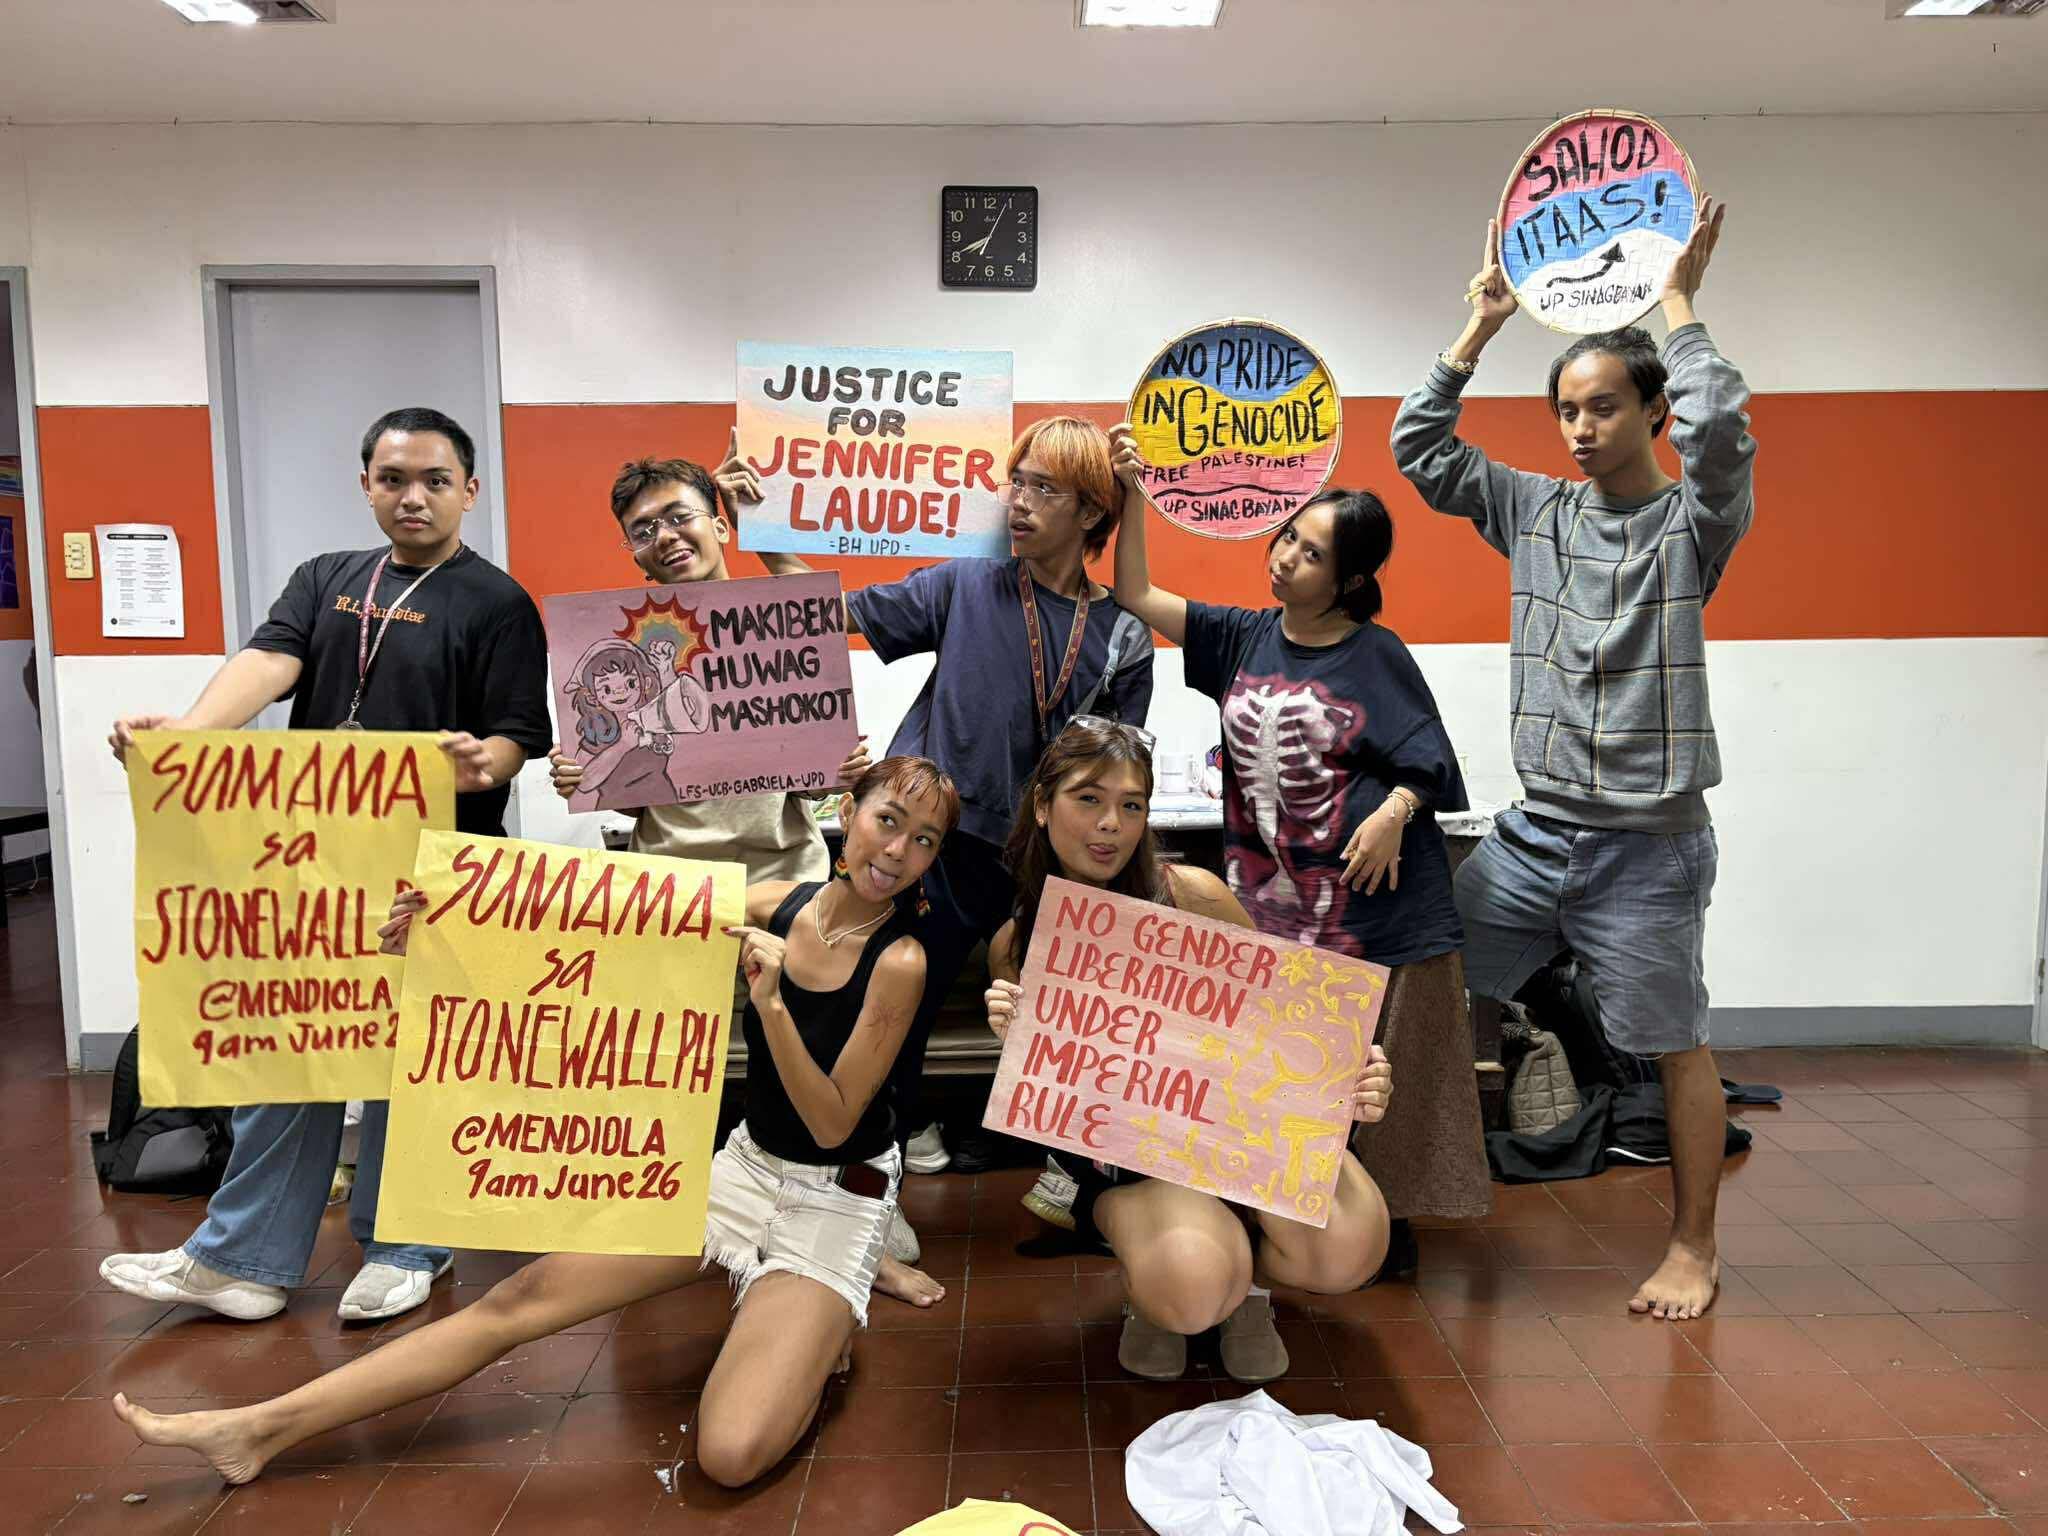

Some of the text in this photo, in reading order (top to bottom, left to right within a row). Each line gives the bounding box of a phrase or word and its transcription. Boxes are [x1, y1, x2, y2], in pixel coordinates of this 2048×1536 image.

[1523, 124, 1659, 202] SAHOD
[950, 210, 964, 222] 10
[965, 196, 976, 209] 11
[983, 196, 997, 209] 12
[1017, 211, 1027, 224] 2
[1516, 177, 1668, 266] ITAAS!
[951, 230, 961, 242] 9
[951, 251, 961, 263] 8
[1016, 252, 1027, 264] 4
[1017, 231, 1027, 243] 3
[966, 265, 976, 277] 7
[984, 265, 995, 277] 6
[1003, 265, 1014, 277] 5
[1540, 293, 1564, 311] UP
[763, 364, 962, 407] JUSTICE
[1161, 338, 1304, 391] NO PRIDE
[827, 406, 906, 437] FOR
[1177, 381, 1329, 457] GENOCIDE
[747, 435, 998, 492] JENNIFER
[1142, 452, 1305, 484] FREE PALESTINE!
[790, 482, 961, 538] LAUDE!
[1164, 499, 1188, 514] UP
[710, 597, 845, 648] MAKIBEKI
[702, 645, 821, 692] HUWAG
[711, 688, 852, 732] MASHOKOT
[152, 741, 428, 819] SUMAMA
[254, 831, 317, 871] sa
[426, 844, 713, 942] SUMAMA
[1055, 895, 1278, 989] NO GENDER
[527, 948, 596, 996] sa
[1044, 935, 1248, 1028] LIBERATION
[198, 975, 394, 1022] @MENDIOLA
[1035, 984, 1163, 1056] UNDER
[192, 1030, 277, 1065] 9am
[1022, 1031, 1216, 1126] IMPERIAL
[451, 1111, 667, 1157] @MENDIOLA
[1005, 1080, 1114, 1150] RULE
